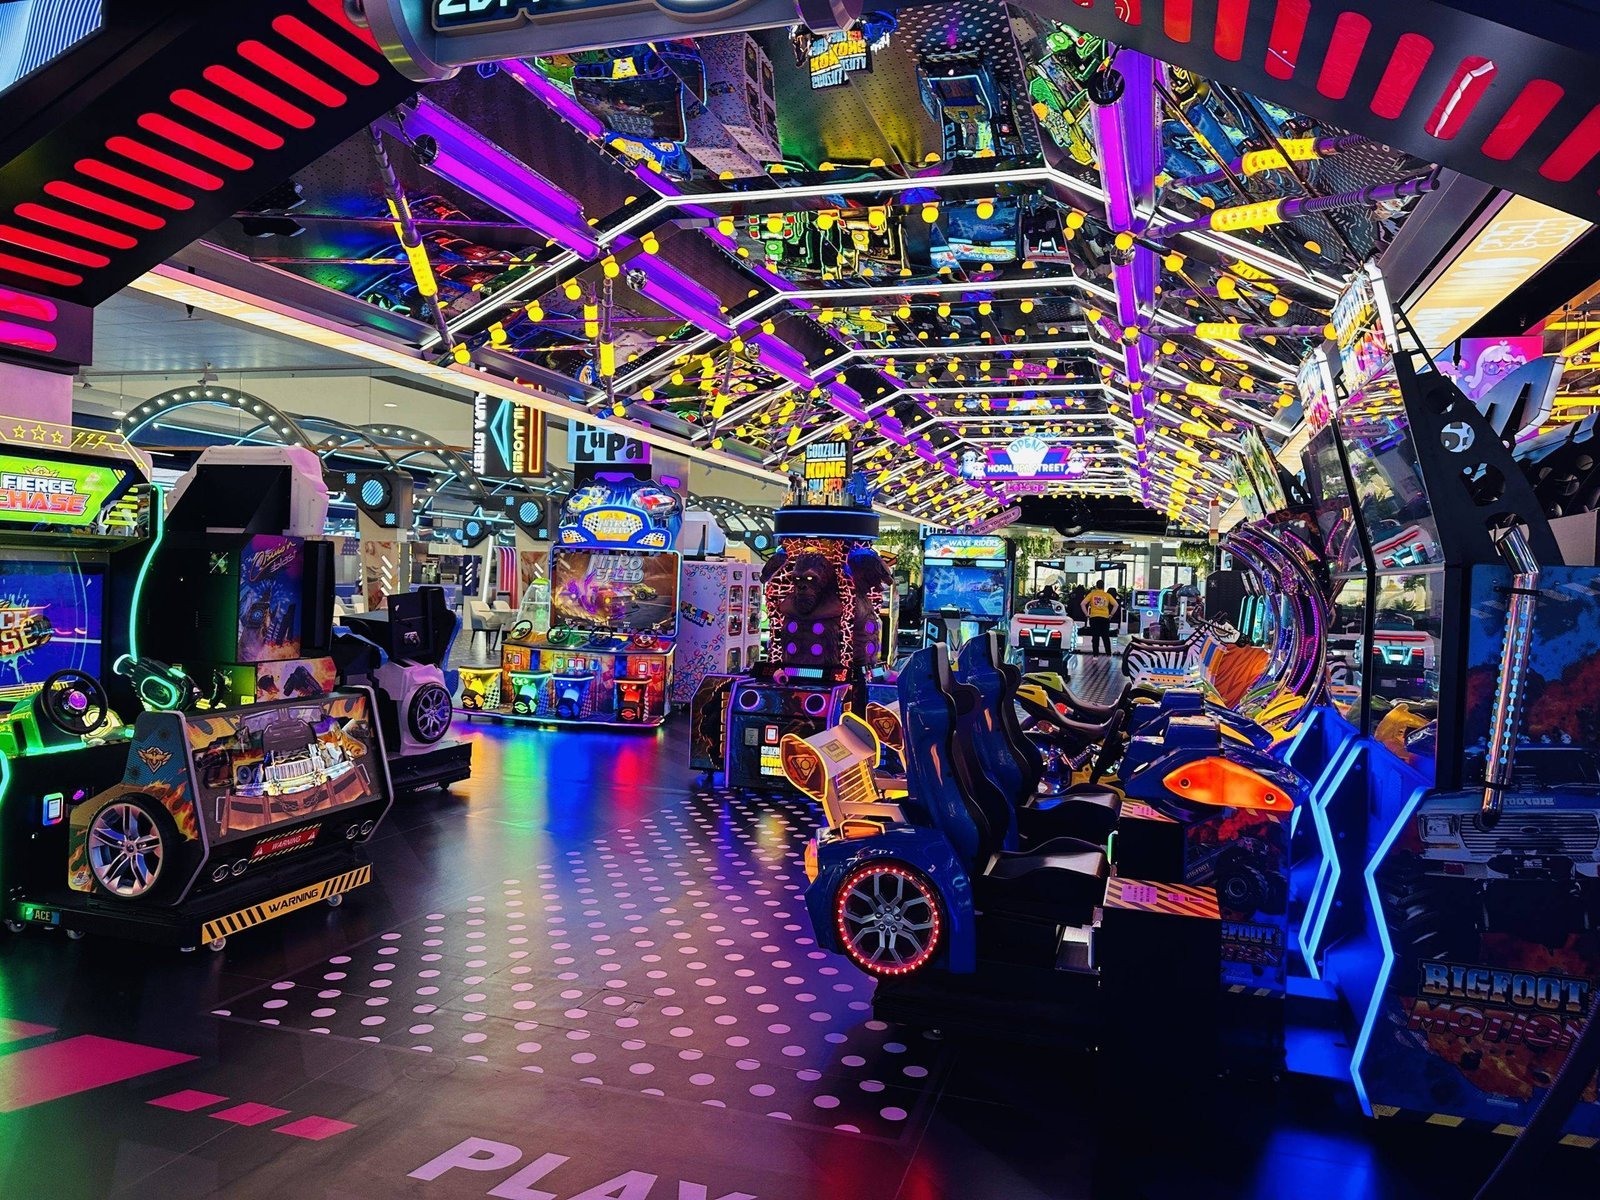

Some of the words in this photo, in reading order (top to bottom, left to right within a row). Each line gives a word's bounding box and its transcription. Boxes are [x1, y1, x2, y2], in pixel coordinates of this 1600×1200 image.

[473, 432, 486, 475] STREET
[806, 442, 847, 459] GODZILLA
[1010, 439, 1046, 453] OPEN!
[805, 461, 847, 479] KONG
[987, 464, 1033, 473] HOPALUPA
[1033, 463, 1066, 472] STREET
[2, 474, 76, 495] FIERCE
[1007, 483, 1031, 491] Let's
[1032, 485, 1045, 493] go
[599, 519, 630, 528] NITRO
[949, 539, 971, 547] WAVE
[973, 538, 1000, 547] RIDERS
[588, 555, 643, 571] NITRO
[271, 835, 302, 851] WARNING
[268, 888, 318, 913] WARNING
[34, 909, 51, 921] ACE
[1422, 963, 1589, 1012] BIGFOOT
